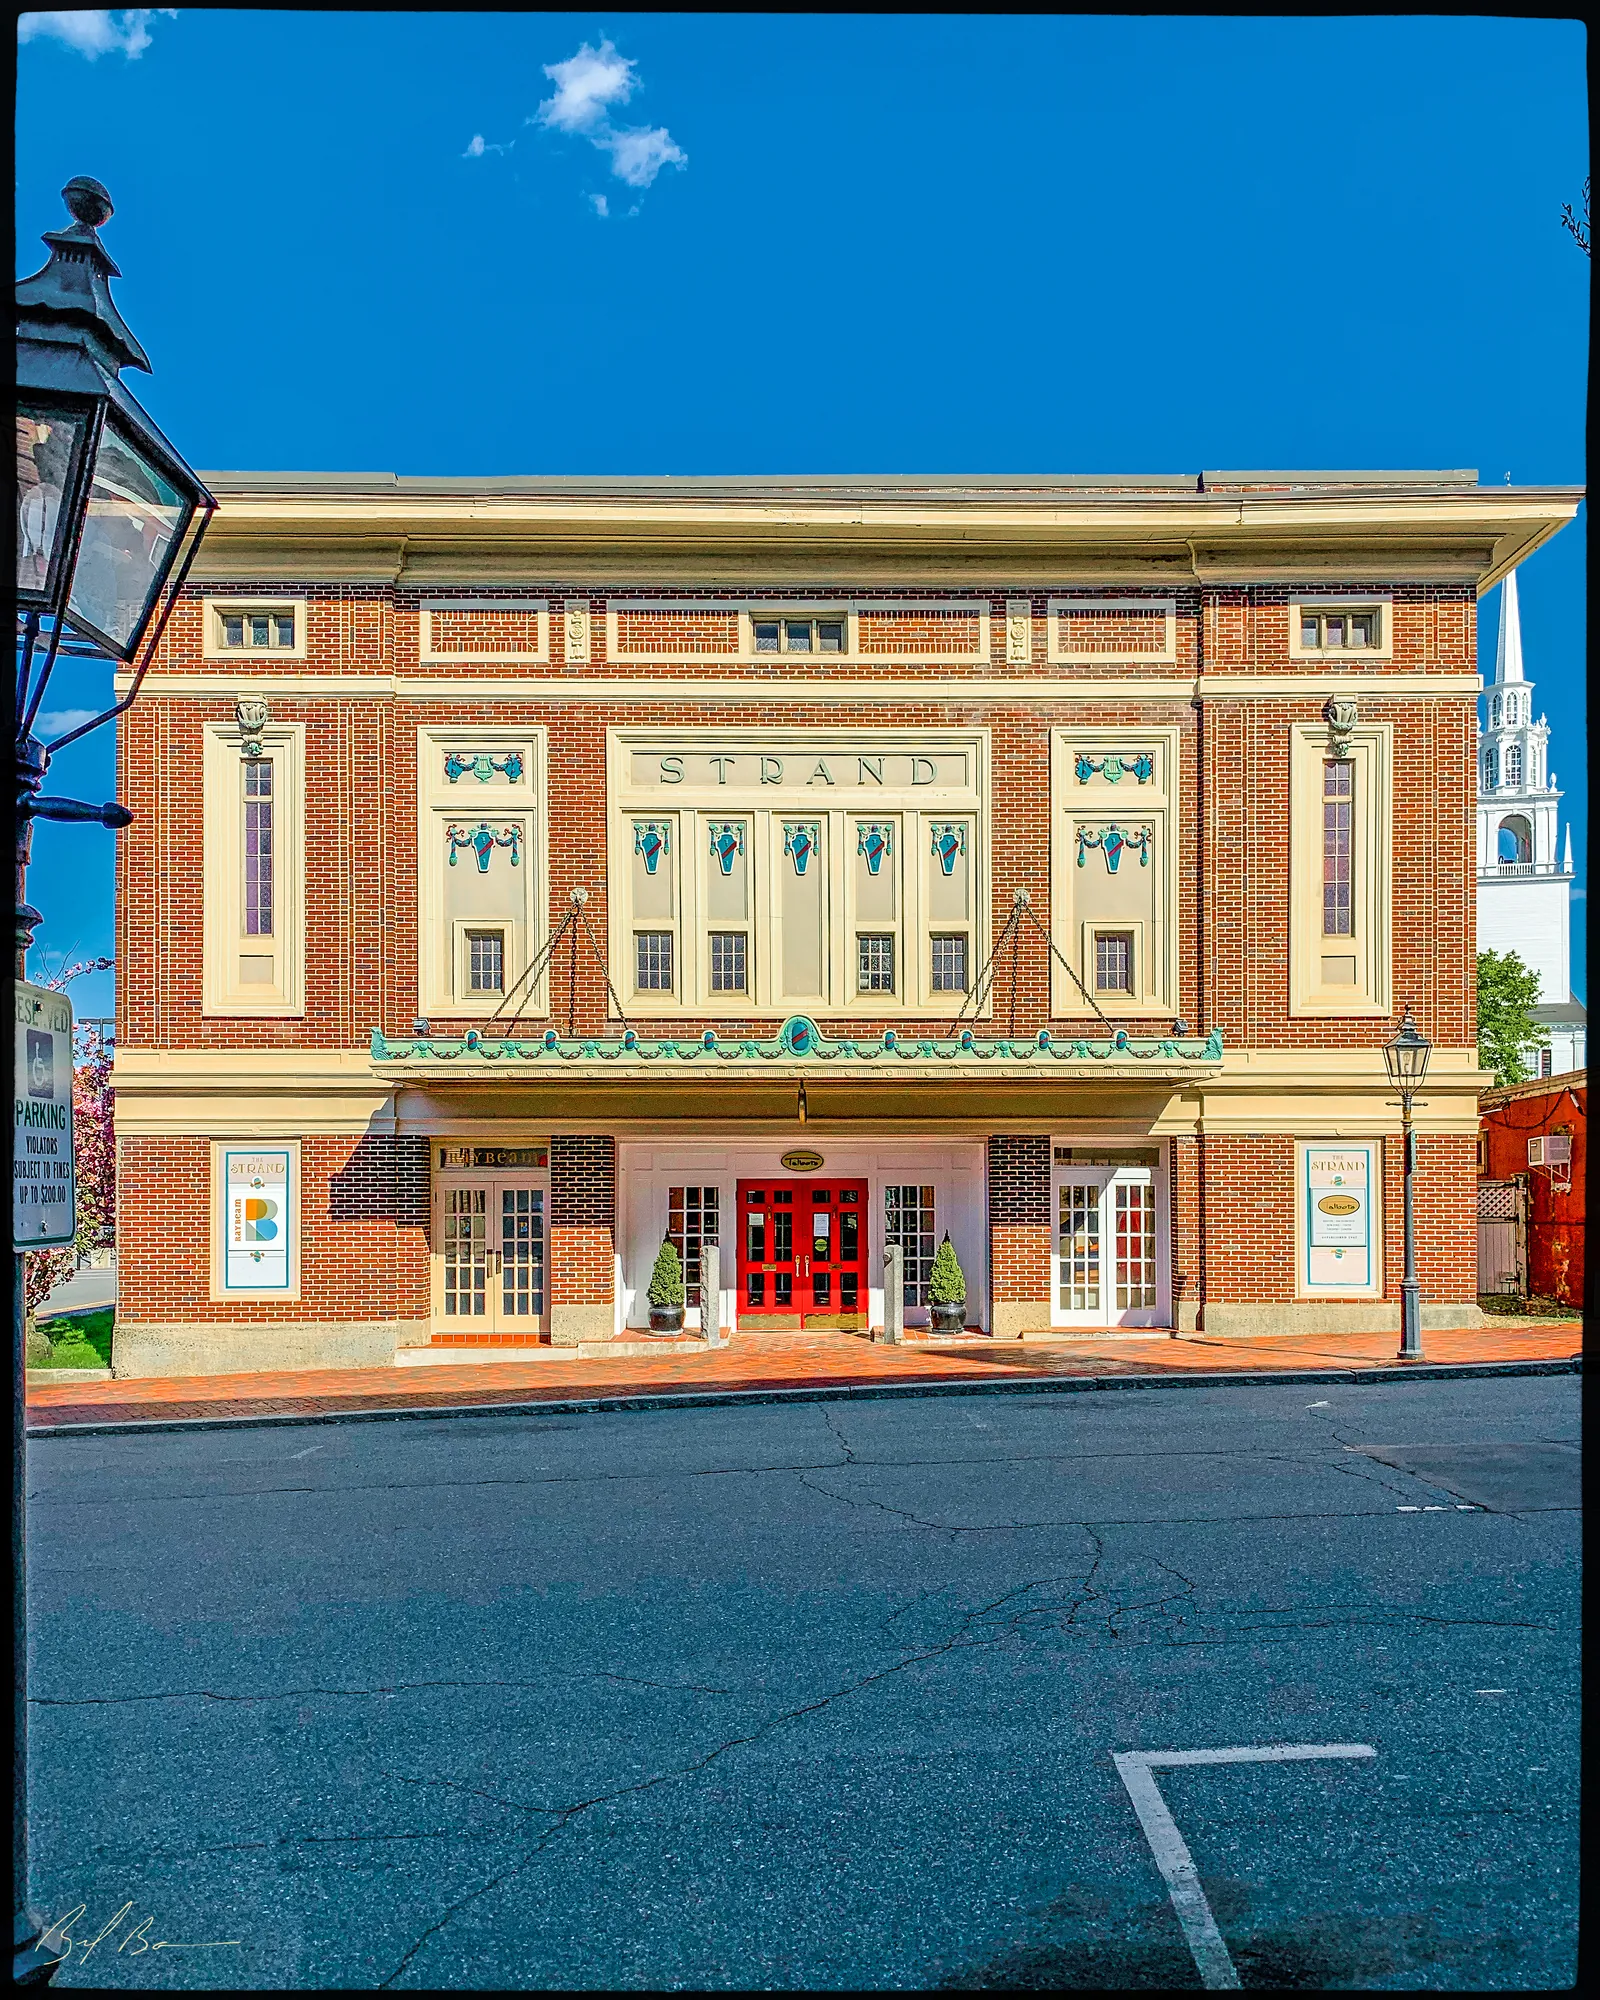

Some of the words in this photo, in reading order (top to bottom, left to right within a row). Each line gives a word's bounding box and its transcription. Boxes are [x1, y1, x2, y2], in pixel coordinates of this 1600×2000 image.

[660, 756, 938, 785] STRAND
[16, 1100, 66, 1130] PARKING
[26, 1136, 58, 1155] VIOLATORS
[14, 1160, 41, 1179] SUBJECT
[43, 1161, 51, 1179] TO
[53, 1162, 70, 1179] FINES
[230, 1163, 285, 1174] STRAND
[1311, 1161, 1365, 1172] STRAND
[20, 1186, 29, 1204] UP
[31, 1186, 39, 1204] TO
[41, 1184, 66, 1205] $200.00
